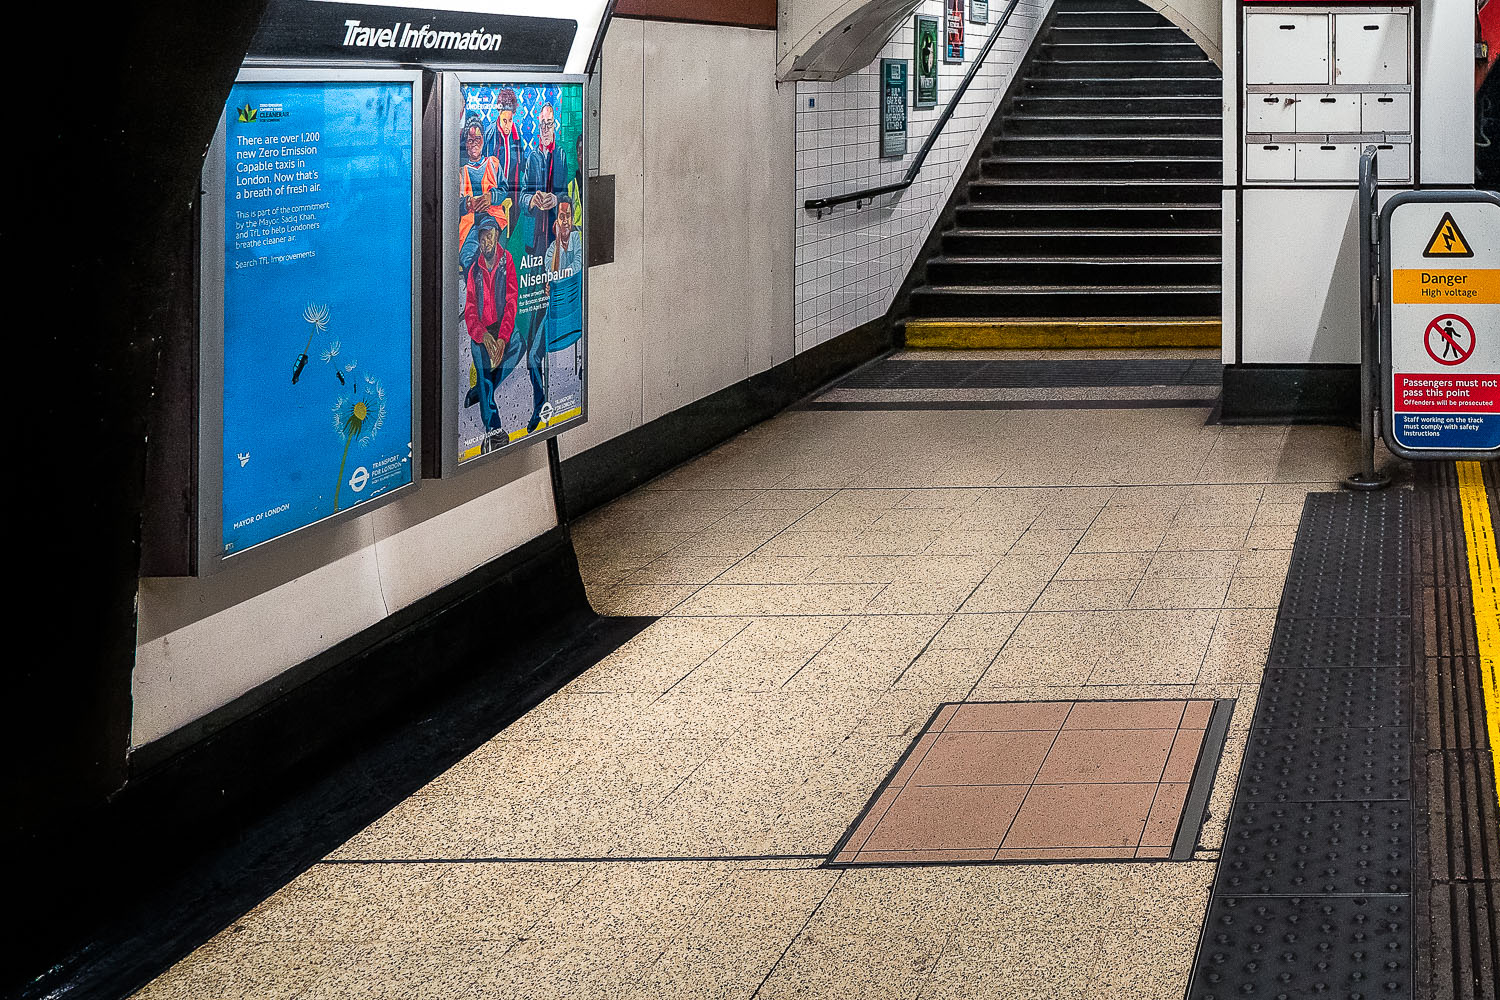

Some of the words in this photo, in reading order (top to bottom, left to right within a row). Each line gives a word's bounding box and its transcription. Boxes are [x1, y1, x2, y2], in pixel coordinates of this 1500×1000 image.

[343, 20, 400, 47] Travel
[400, 23, 502, 50] Information
[237, 136, 262, 145] There
[281, 135, 299, 143] over
[237, 150, 256, 159] new
[259, 148, 279, 157] Zero
[282, 146, 317, 156] Emission
[237, 161, 273, 174] Capable
[275, 160, 295, 169] taxis
[298, 159, 305, 167] in
[237, 175, 271, 186] London.
[274, 173, 294, 182] Now
[244, 186, 272, 198] breath
[275, 185, 284, 195] of
[287, 184, 307, 194] fresh
[310, 183, 321, 192] air.
[236, 211, 249, 219] This
[258, 209, 270, 218] part
[272, 207, 279, 215] of
[292, 202, 330, 212] commitment
[236, 222, 244, 232] by
[282, 215, 298, 224] Sadiq
[236, 231, 248, 239] and
[250, 229, 260, 237] TfL
[263, 228, 270, 236] to
[272, 226, 285, 235] help
[287, 222, 319, 232] Londoners
[236, 240, 261, 249] breathe
[263, 236, 285, 246] cleaner
[236, 260, 257, 269] Search
[271, 251, 315, 263] Improvements
[520, 255, 543, 269] Aliza
[520, 268, 573, 288] Nisenbaum
[1421, 273, 1468, 286] Danger
[1422, 289, 1441, 298] High
[1444, 289, 1477, 298] voltage
[1403, 379, 1452, 388] Passengers
[1403, 390, 1423, 398] pass
[1446, 389, 1470, 398] point
[373, 455, 399, 468] TRANSPORT
[372, 469, 381, 477] FOR
[382, 462, 401, 473] LONDON
[233, 516, 254, 530] MAYOR
[256, 513, 264, 521] OF
[265, 503, 290, 518] LONDON
